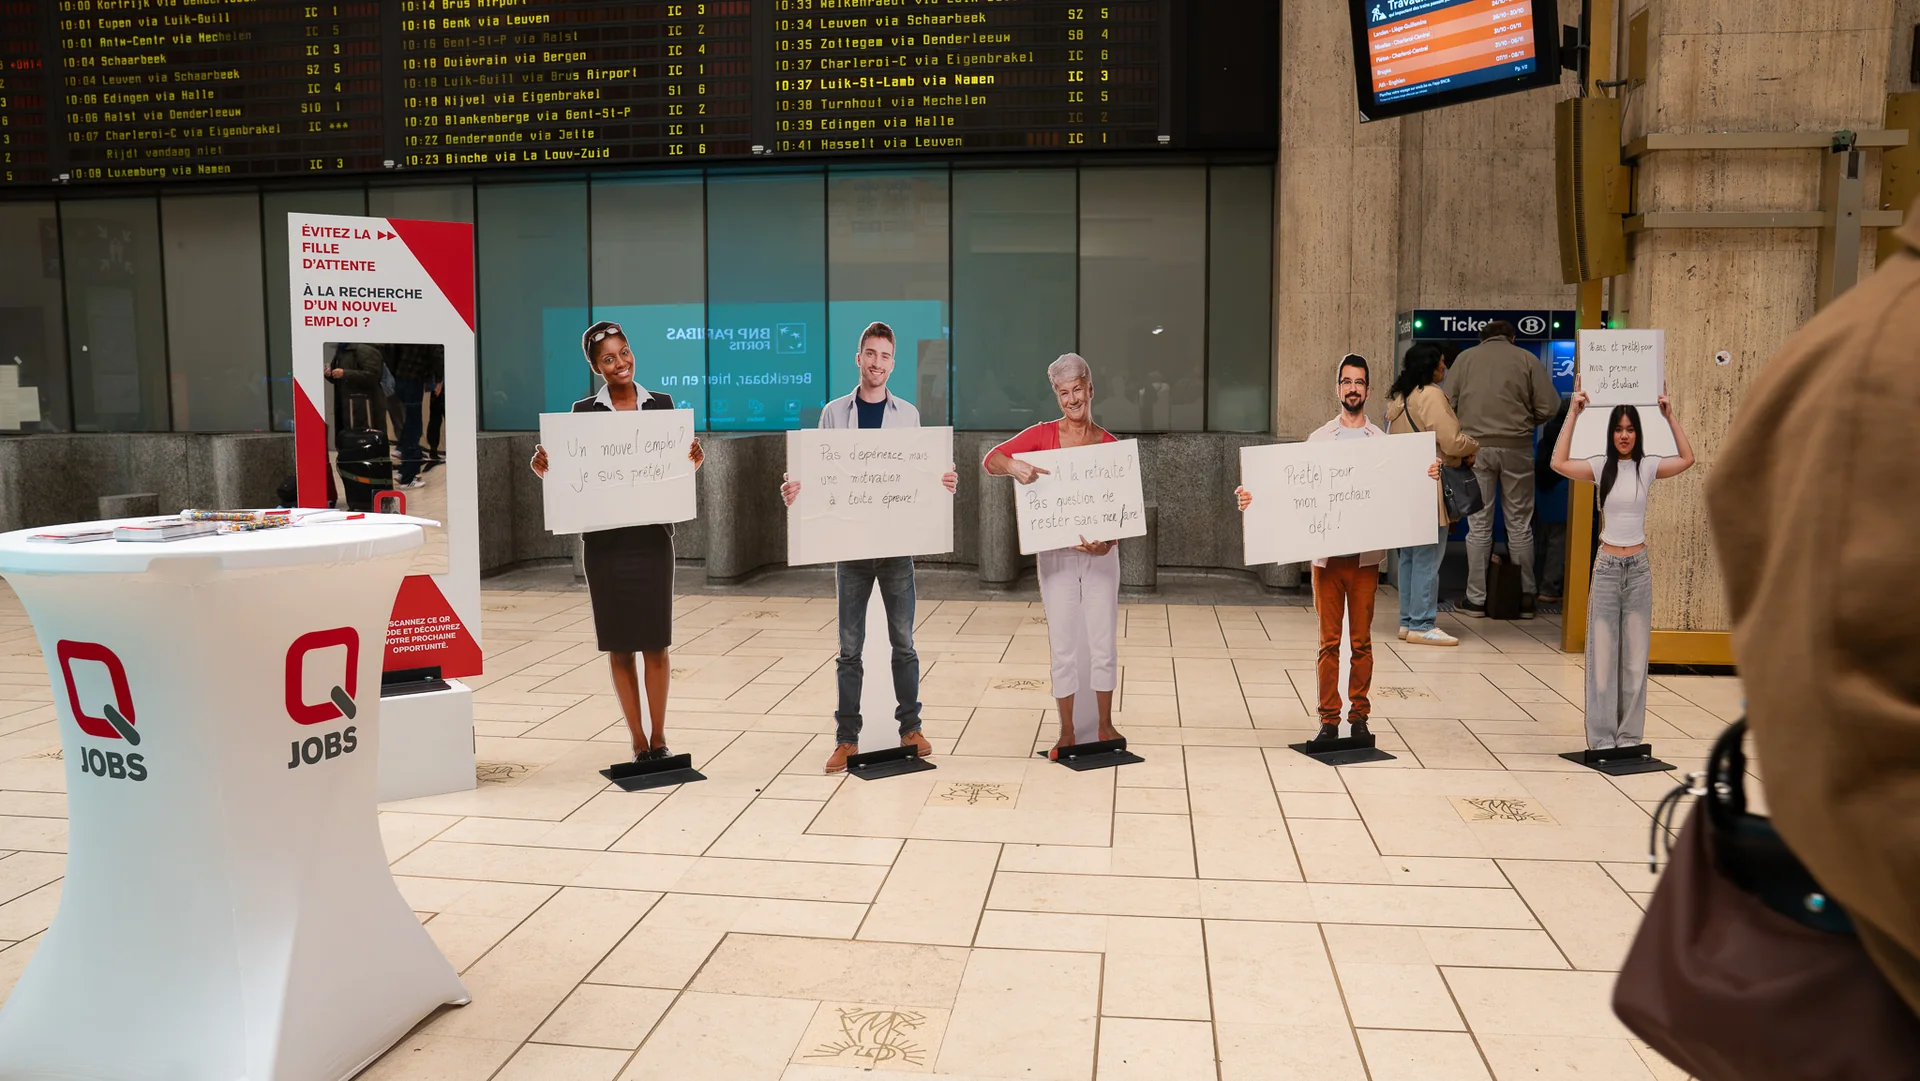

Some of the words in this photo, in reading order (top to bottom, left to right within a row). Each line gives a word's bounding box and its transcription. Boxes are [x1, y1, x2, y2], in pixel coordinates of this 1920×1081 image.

[60, 19, 91, 30] 10:01
[98, 18, 131, 29] Eupen
[138, 16, 158, 27] via
[164, 12, 230, 26] Luik-Guill
[304, 6, 318, 19] IC
[332, 5, 338, 16] 1
[402, 19, 435, 31] 10:16
[443, 17, 471, 29] Genk
[478, 16, 499, 27] via
[506, 14, 549, 25] Leuven
[668, 5, 682, 16] IC
[698, 4, 705, 15] 3
[776, 19, 812, 30] 10:34
[820, 19, 867, 29] Leuven
[876, 16, 898, 26] via
[907, 12, 986, 25] Schaarbeek
[1068, 9, 1083, 19] S2
[1101, 8, 1108, 18] 5
[64, 57, 94, 67] 10:04
[101, 54, 166, 66] Schaarbeek
[306, 45, 319, 56] IC
[334, 44, 340, 54] 3
[776, 79, 812, 91] 10:37
[821, 76, 914, 89] Luik-St-Lamb
[923, 75, 946, 86] via
[955, 74, 994, 85] Namen
[1069, 71, 1083, 82] IC
[1101, 70, 1108, 81] 3
[66, 94, 96, 104] 10:06
[103, 94, 149, 104] Edingen
[156, 93, 175, 101] via
[182, 90, 214, 100] Halle
[308, 83, 320, 94] IC
[335, 82, 341, 92] 4
[776, 100, 812, 111] 10:38
[820, 97, 881, 109] Turnhout
[892, 96, 914, 107] via
[923, 94, 986, 107] Mechelen
[1068, 91, 1083, 102] IC
[1101, 90, 1108, 102] 5
[404, 116, 438, 127] 10:20
[445, 113, 529, 125] Blankenberge
[537, 110, 558, 121] via
[566, 106, 631, 120] Gent-St-P
[669, 104, 683, 115] IC
[699, 103, 705, 114] 2
[405, 154, 439, 167] 10:23
[445, 152, 488, 164] Binche
[495, 151, 516, 162] via
[523, 150, 537, 161] La
[544, 147, 609, 160] Louv-Zuid
[669, 144, 683, 155] IC
[699, 143, 706, 154] 6
[71, 168, 101, 179] 10:08
[108, 167, 166, 178] Luxemburg
[172, 166, 191, 175] via
[197, 164, 230, 174] Namen
[310, 159, 323, 170] IC
[337, 158, 343, 168] 3
[302, 224, 350, 238] ÉVITEZ
[354, 229, 371, 240] LA
[302, 242, 340, 254] FILLE
[302, 258, 376, 272] D'ATTENTE
[303, 283, 313, 296] À
[318, 286, 335, 297] LA
[339, 287, 423, 299] RECHERCHE
[304, 300, 337, 311] D'UN
[342, 301, 397, 312] NOUVEL
[304, 316, 358, 327] EMPLOI
[363, 317, 370, 327] ?
[1608, 366, 1638, 377] premier
[1611, 377, 1640, 389] étudiant
[567, 437, 587, 458] Un
[600, 429, 639, 457] nouvel
[820, 443, 841, 461] Pas
[597, 469, 624, 482] suis
[850, 472, 902, 484] motivation
[1069, 462, 1079, 481] la
[1329, 465, 1354, 490] pour
[829, 493, 836, 505] à
[848, 492, 873, 505] toute
[1025, 490, 1048, 511] Pas
[1056, 492, 1095, 515] question
[1102, 488, 1115, 503] de
[1293, 497, 1317, 510] mon
[1328, 485, 1371, 512] prochain
[1030, 512, 1070, 530] rester
[1073, 513, 1098, 526] sans
[385, 629, 402, 637] ODE
[403, 627, 413, 635] ET
[414, 623, 460, 634] DÉCOUVREZ
[389, 617, 426, 627] SCANNEZ
[427, 616, 437, 624] CE
[439, 615, 451, 623] QR
[411, 632, 456, 642] PROCHAINE
[288, 726, 357, 769] JOBS
[81, 746, 148, 782] JOBS
